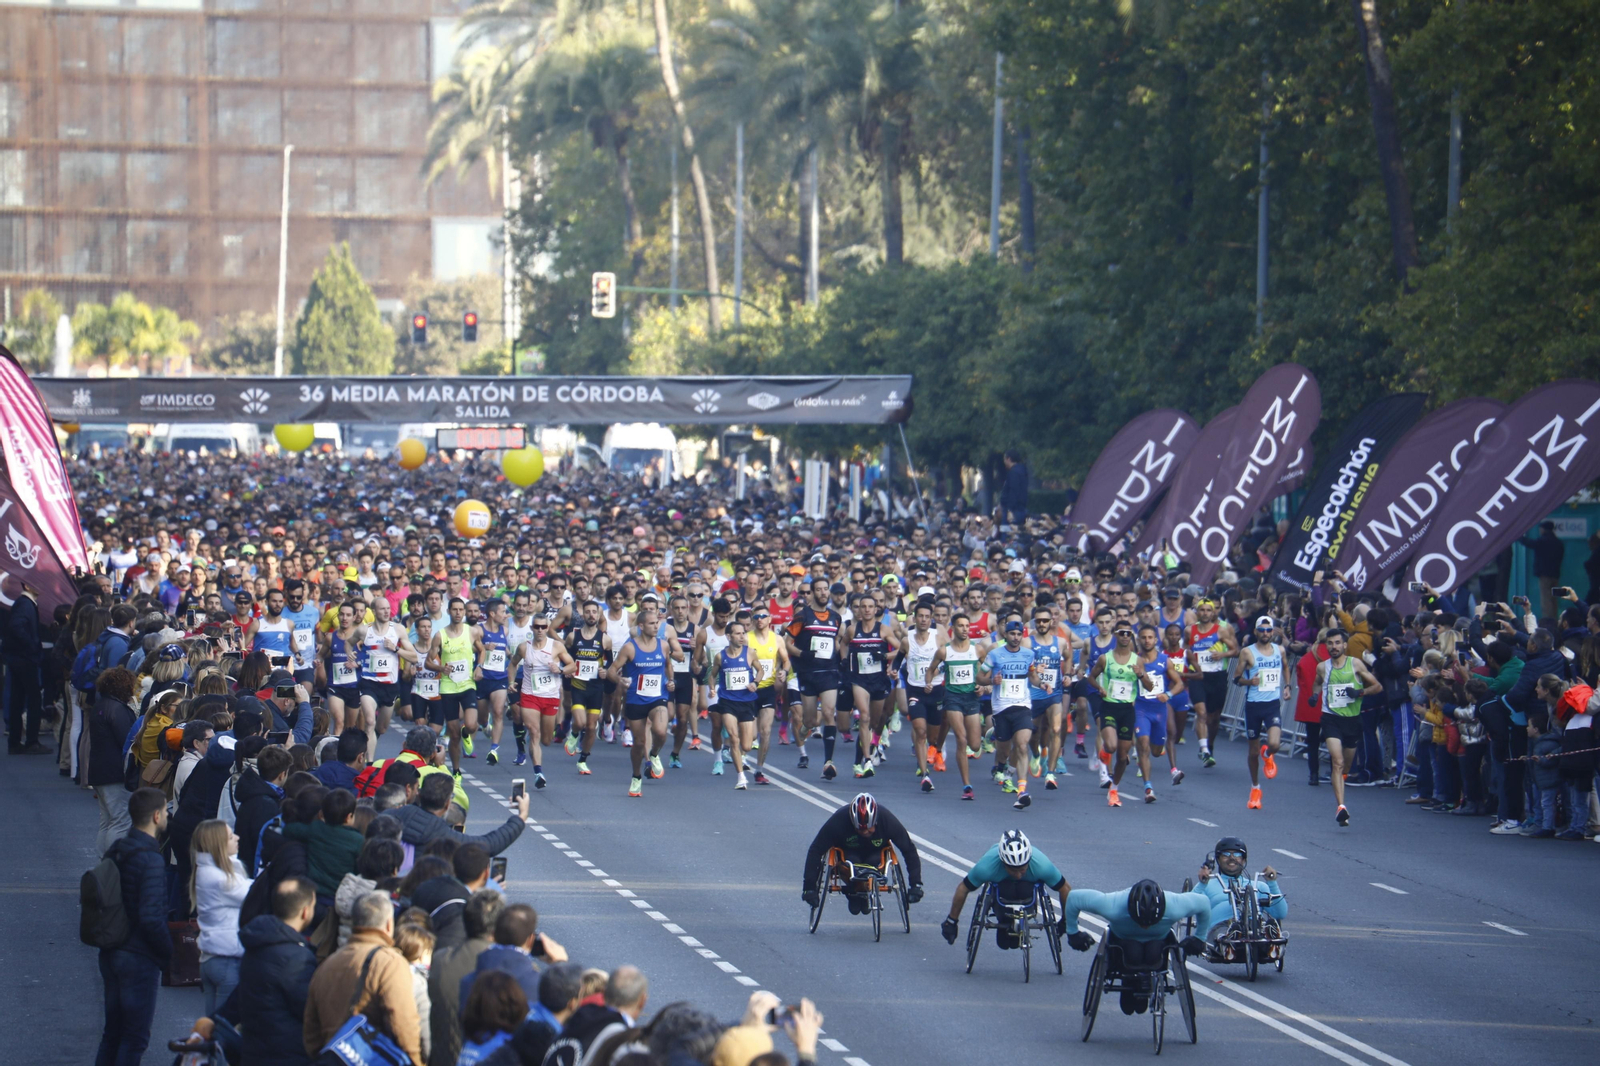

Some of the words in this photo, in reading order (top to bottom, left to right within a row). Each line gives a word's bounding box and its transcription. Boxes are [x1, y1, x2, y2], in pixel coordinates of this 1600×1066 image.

[299, 385, 324, 402] 36
[331, 386, 399, 402] MEDIA
[407, 381, 515, 402] MARATÓN
[523, 386, 549, 402] DE
[556, 381, 664, 402] CÓRDOBA
[157, 394, 215, 406] IMDECO
[455, 405, 510, 418] SALIDA
[1200, 374, 1308, 562] IMDECO
[1078, 416, 1186, 554] IMDEC
[1414, 397, 1600, 594] IMDECO
[1294, 437, 1376, 571] Especolchón
[1378, 543, 1409, 570] Instituto
[298, 634, 308, 642] 20
[819, 641, 829, 650] 87
[377, 659, 387, 667] 64
[1258, 658, 1280, 668] nerja
[581, 665, 594, 673] 281
[956, 669, 970, 678] 454
[538, 675, 552, 684] 133
[732, 676, 746, 684] 349
[1039, 672, 1053, 682] 338
[1266, 673, 1278, 682] 131
[645, 678, 658, 687] 350
[424, 684, 434, 692] 14
[1010, 684, 1020, 692] 15
[1120, 686, 1125, 694] 2
[1335, 689, 1348, 697] 32
